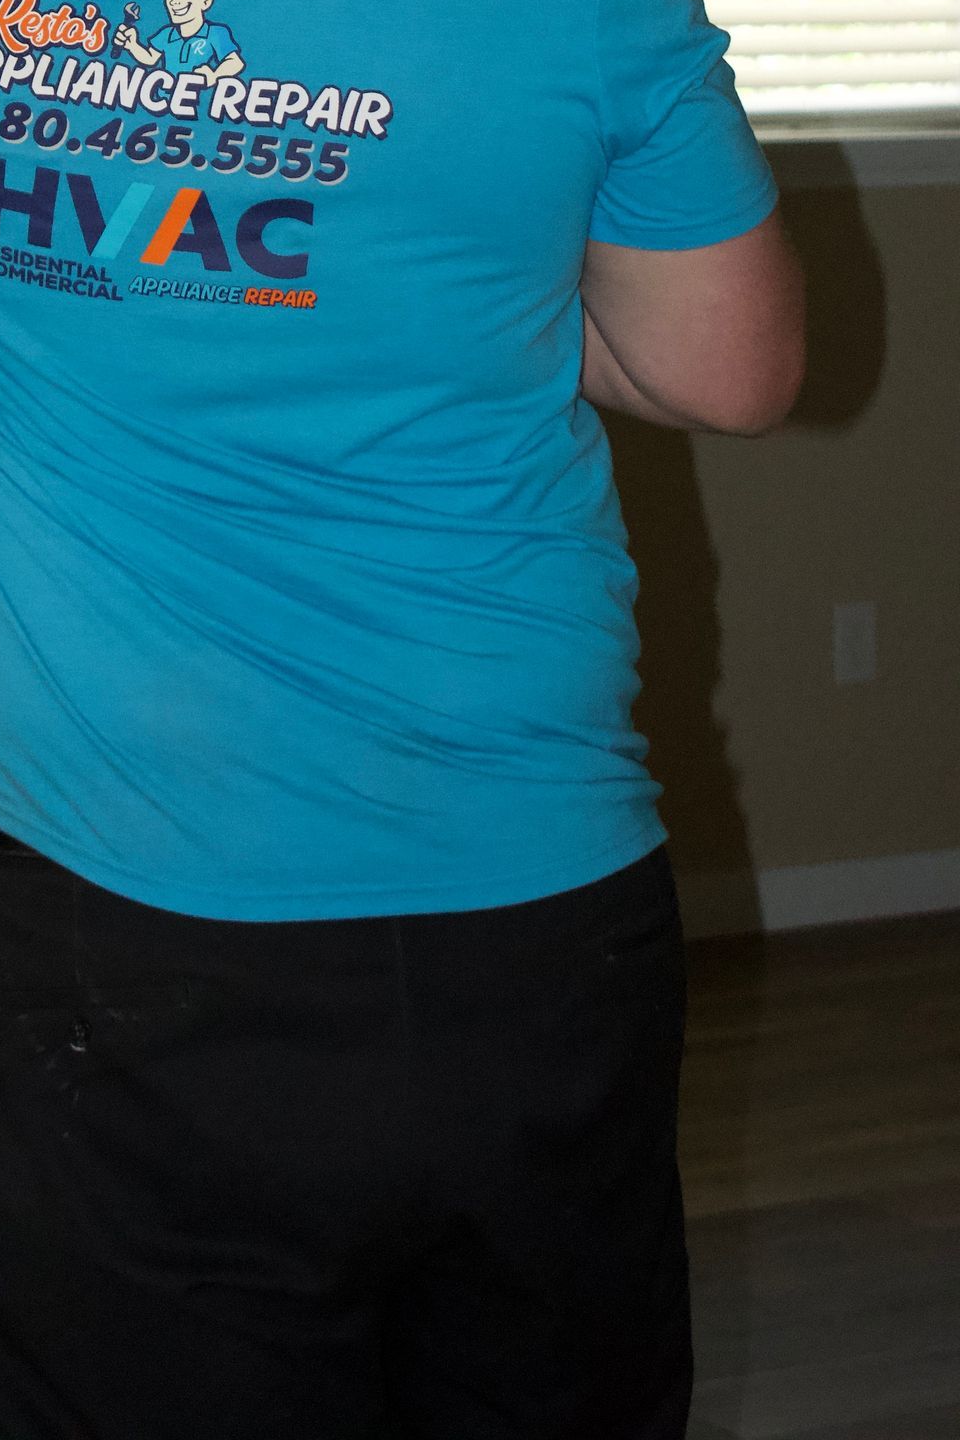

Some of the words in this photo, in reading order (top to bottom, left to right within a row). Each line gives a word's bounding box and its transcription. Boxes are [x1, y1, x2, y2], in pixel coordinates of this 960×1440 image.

[210, 76, 393, 139] REPAIR
[128, 276, 241, 304] APPLIANCE
[243, 287, 317, 310] REPAIR
